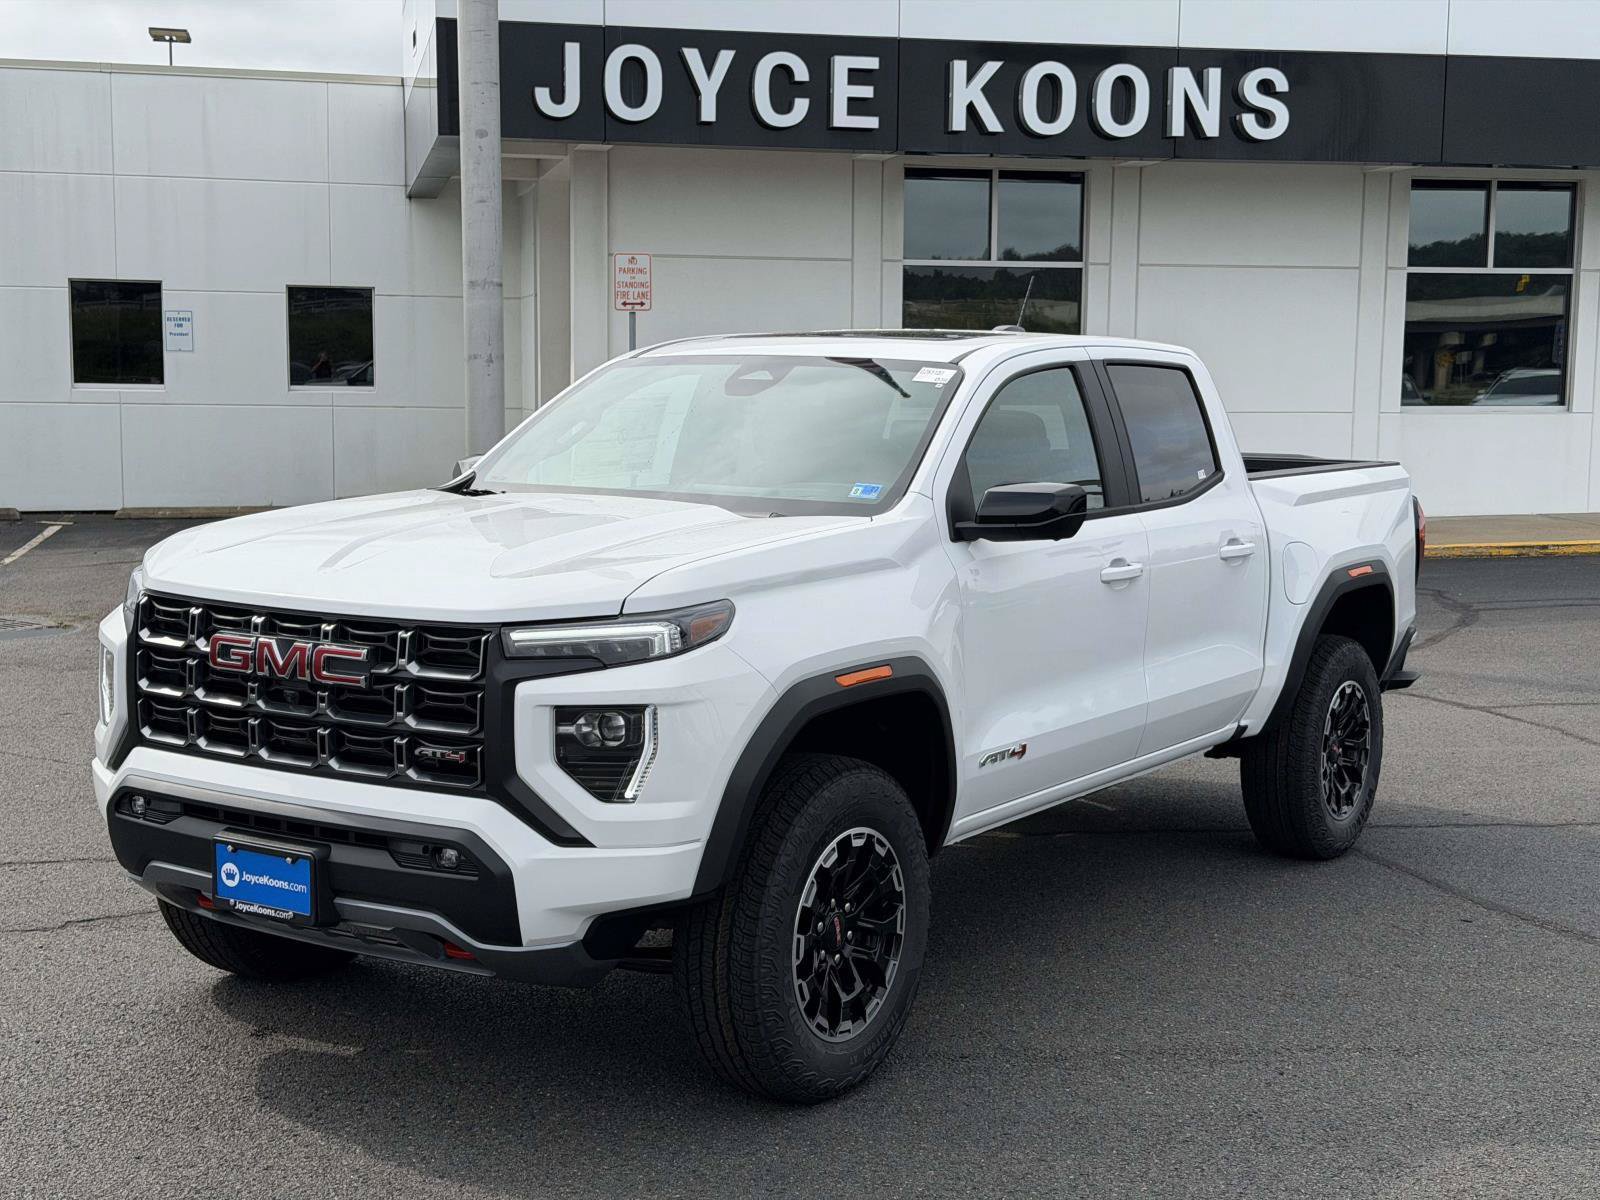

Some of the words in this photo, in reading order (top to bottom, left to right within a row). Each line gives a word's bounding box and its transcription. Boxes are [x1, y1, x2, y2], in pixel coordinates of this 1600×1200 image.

[533, 41, 881, 130] JOYCE
[947, 58, 1291, 141] KOONS
[618, 267, 647, 275] PARKING
[616, 281, 649, 289] STANDING
[616, 290, 631, 300] FIRE
[632, 290, 650, 301] LANE
[208, 633, 368, 688] GMC
[414, 747, 466, 764] AT4
[979, 743, 1027, 768] AT4
[241, 871, 307, 894] JoyceKoons.com
[234, 901, 293, 919] JoyceKoons.com
